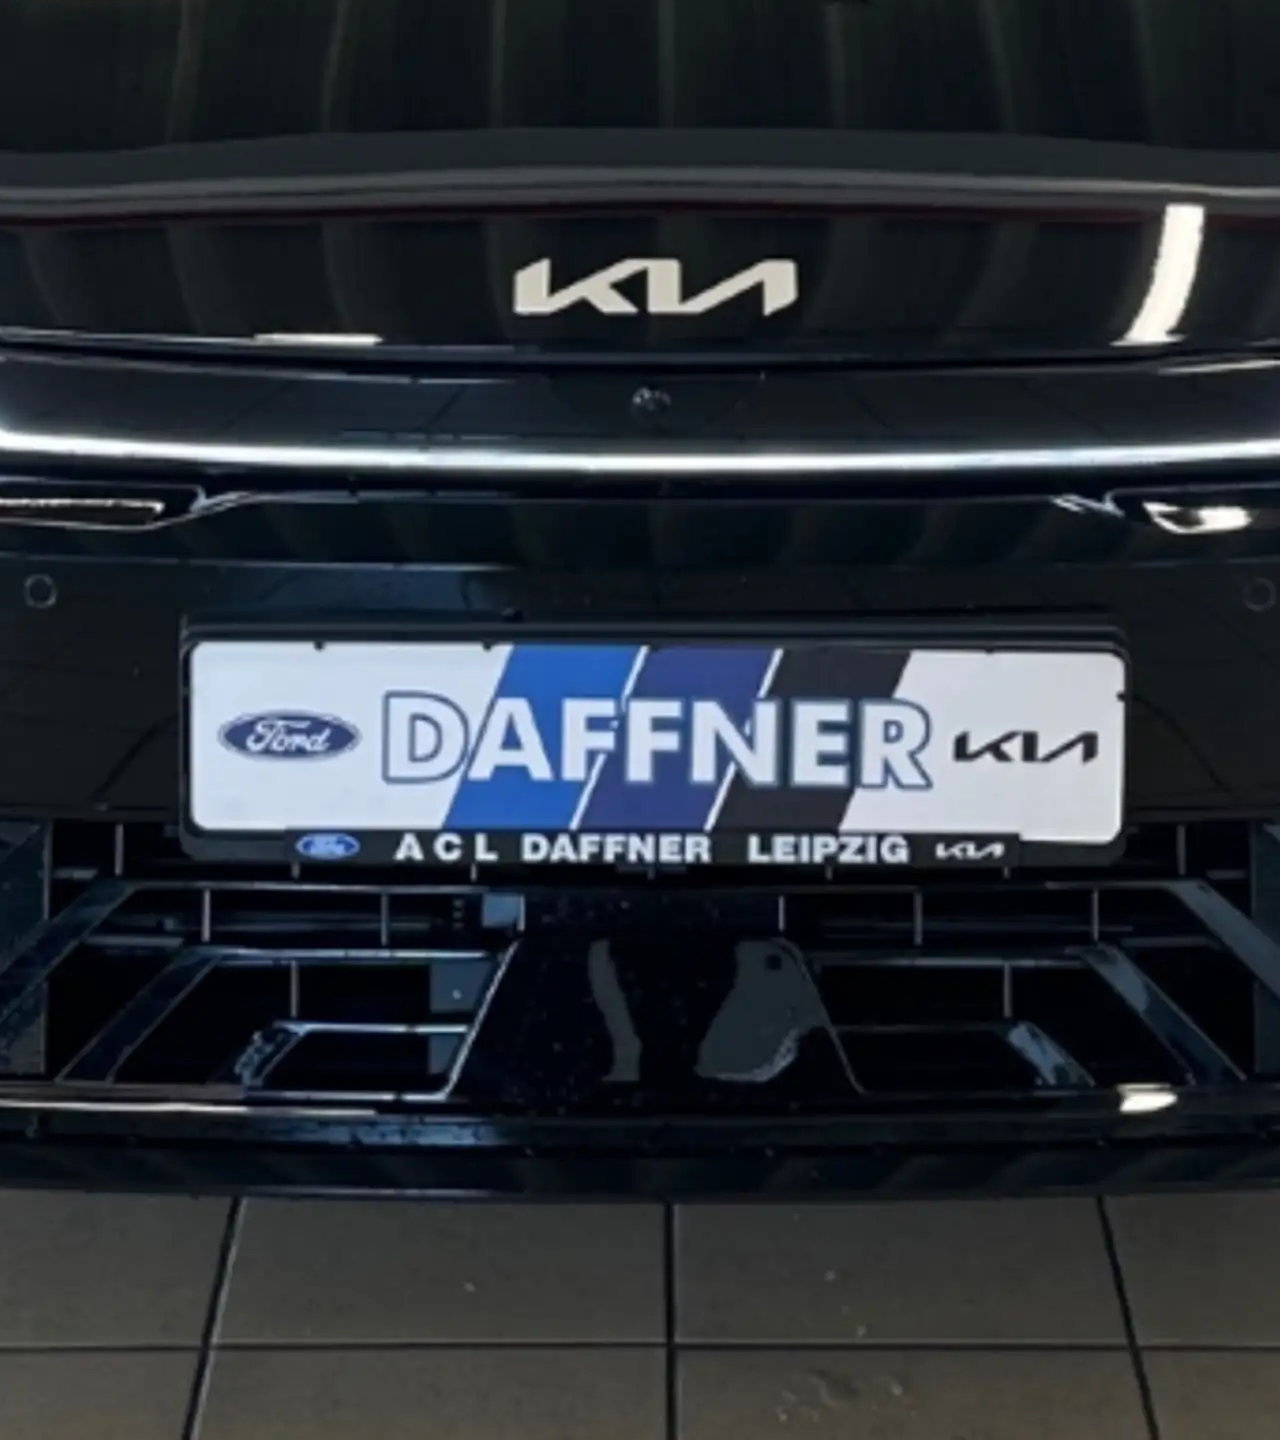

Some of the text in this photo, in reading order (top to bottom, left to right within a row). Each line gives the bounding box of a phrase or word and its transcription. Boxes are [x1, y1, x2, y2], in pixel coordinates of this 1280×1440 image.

[513, 257, 799, 316] KIA
[245, 718, 332, 752] Ford
[381, 691, 932, 790] DAFFNER
[953, 730, 1099, 764] KIA
[522, 834, 712, 863] DAFFNER
[748, 834, 909, 864] LEIPZIG
